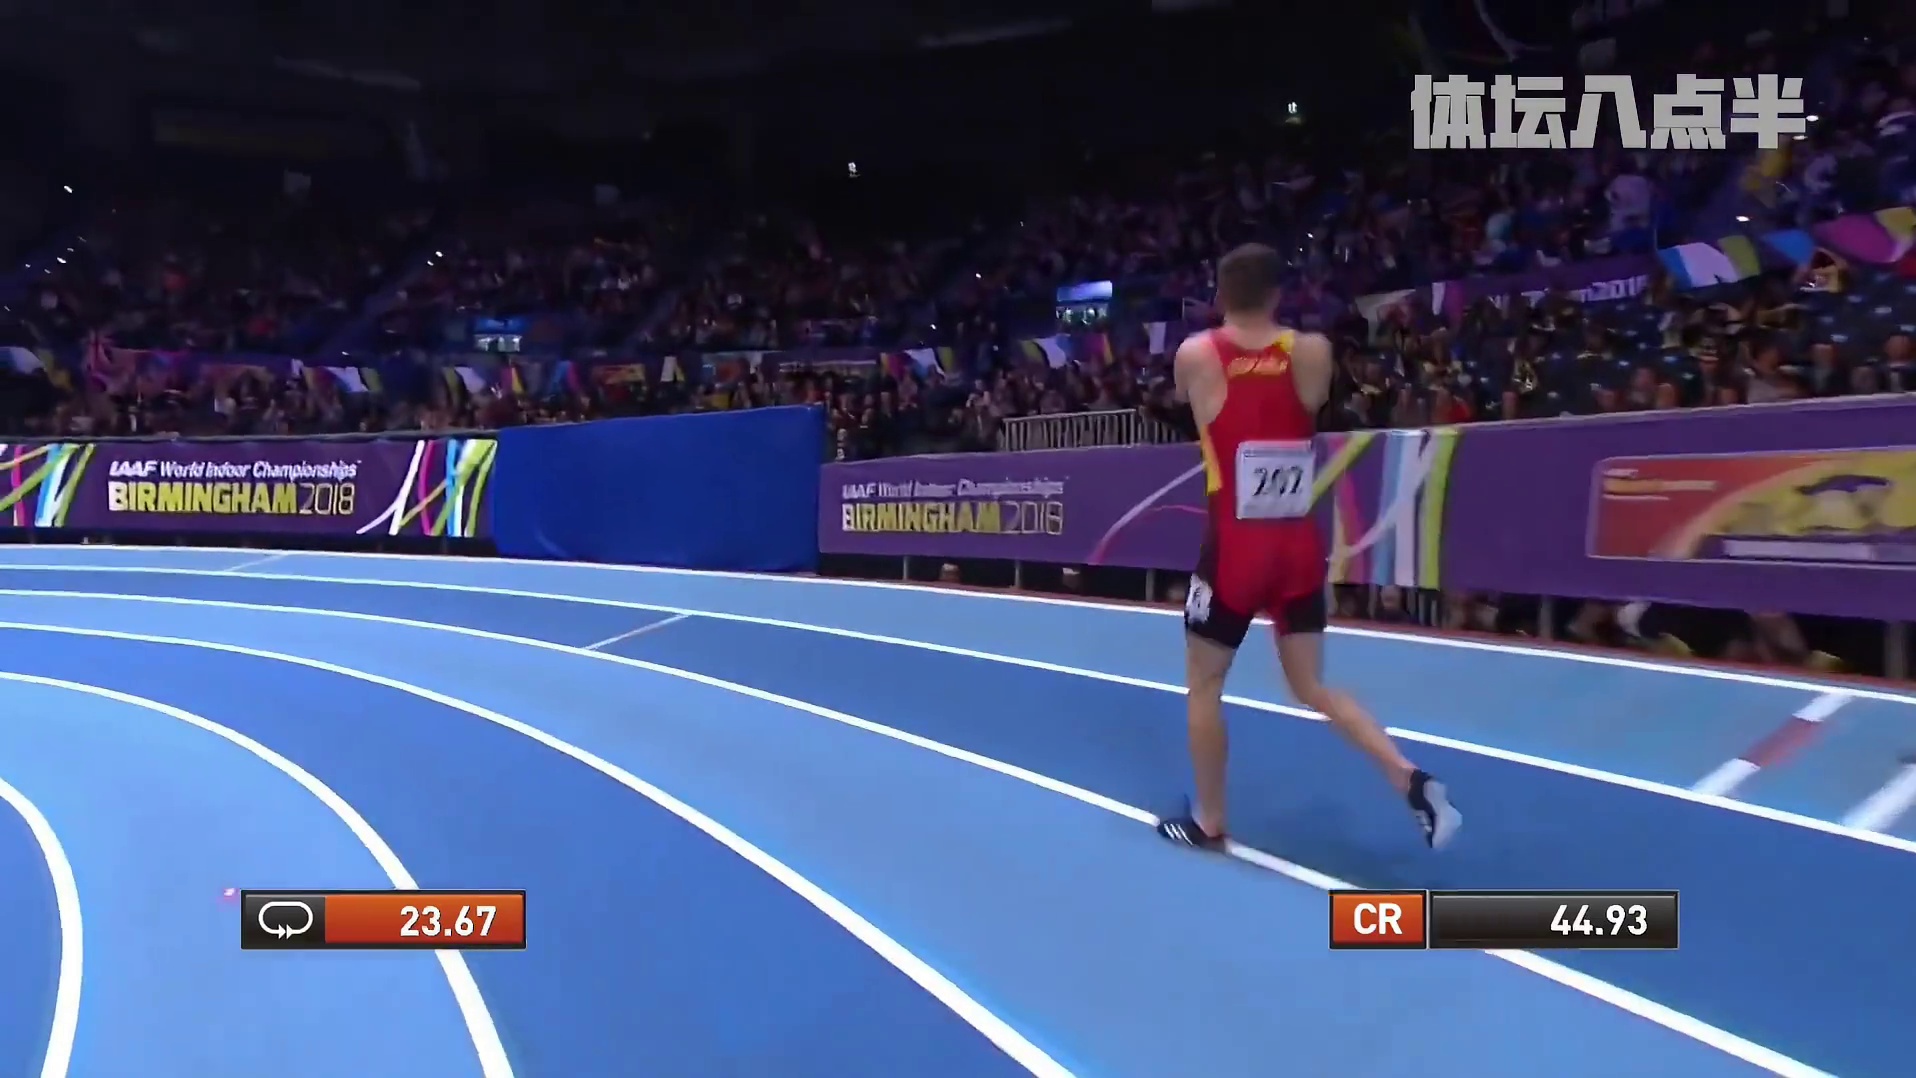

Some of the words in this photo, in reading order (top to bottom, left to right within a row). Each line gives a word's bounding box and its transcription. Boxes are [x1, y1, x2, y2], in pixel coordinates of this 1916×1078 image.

[109, 460, 157, 477] IAAF
[160, 461, 205, 478] World
[205, 461, 251, 478] Indoor
[252, 460, 357, 482] Championships
[108, 481, 297, 514] BIRMINGHAM
[299, 482, 355, 515] 2018
[842, 501, 1000, 533] BIRMINGHAM
[1000, 501, 1063, 535] 2018
